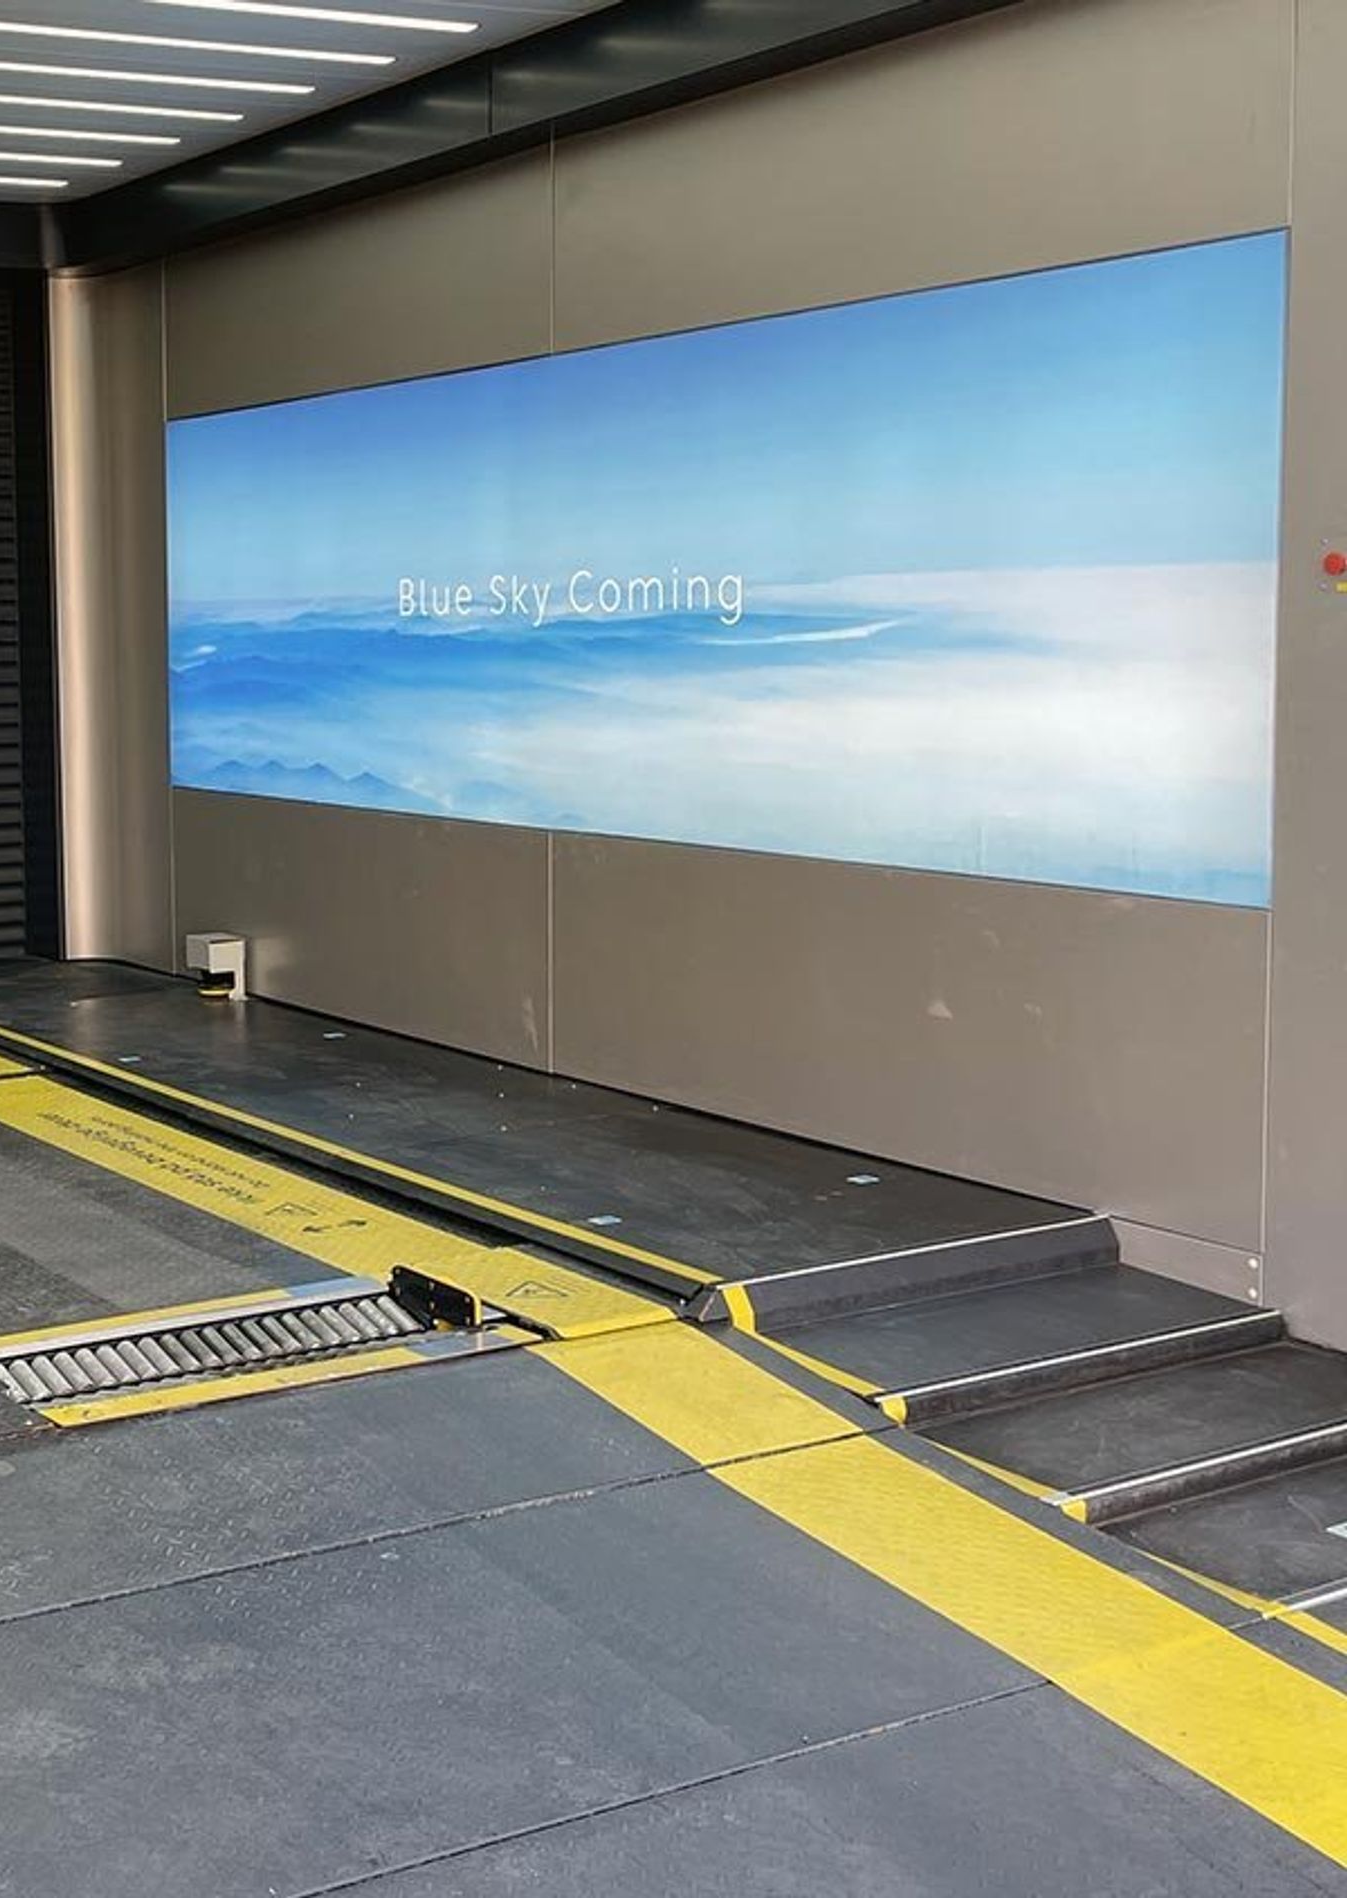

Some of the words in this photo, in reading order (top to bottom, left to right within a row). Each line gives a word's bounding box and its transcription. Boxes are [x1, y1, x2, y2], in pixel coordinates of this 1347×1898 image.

[398, 577, 473, 617] Blue
[489, 574, 551, 628] Sky
[569, 566, 744, 626] Coming
